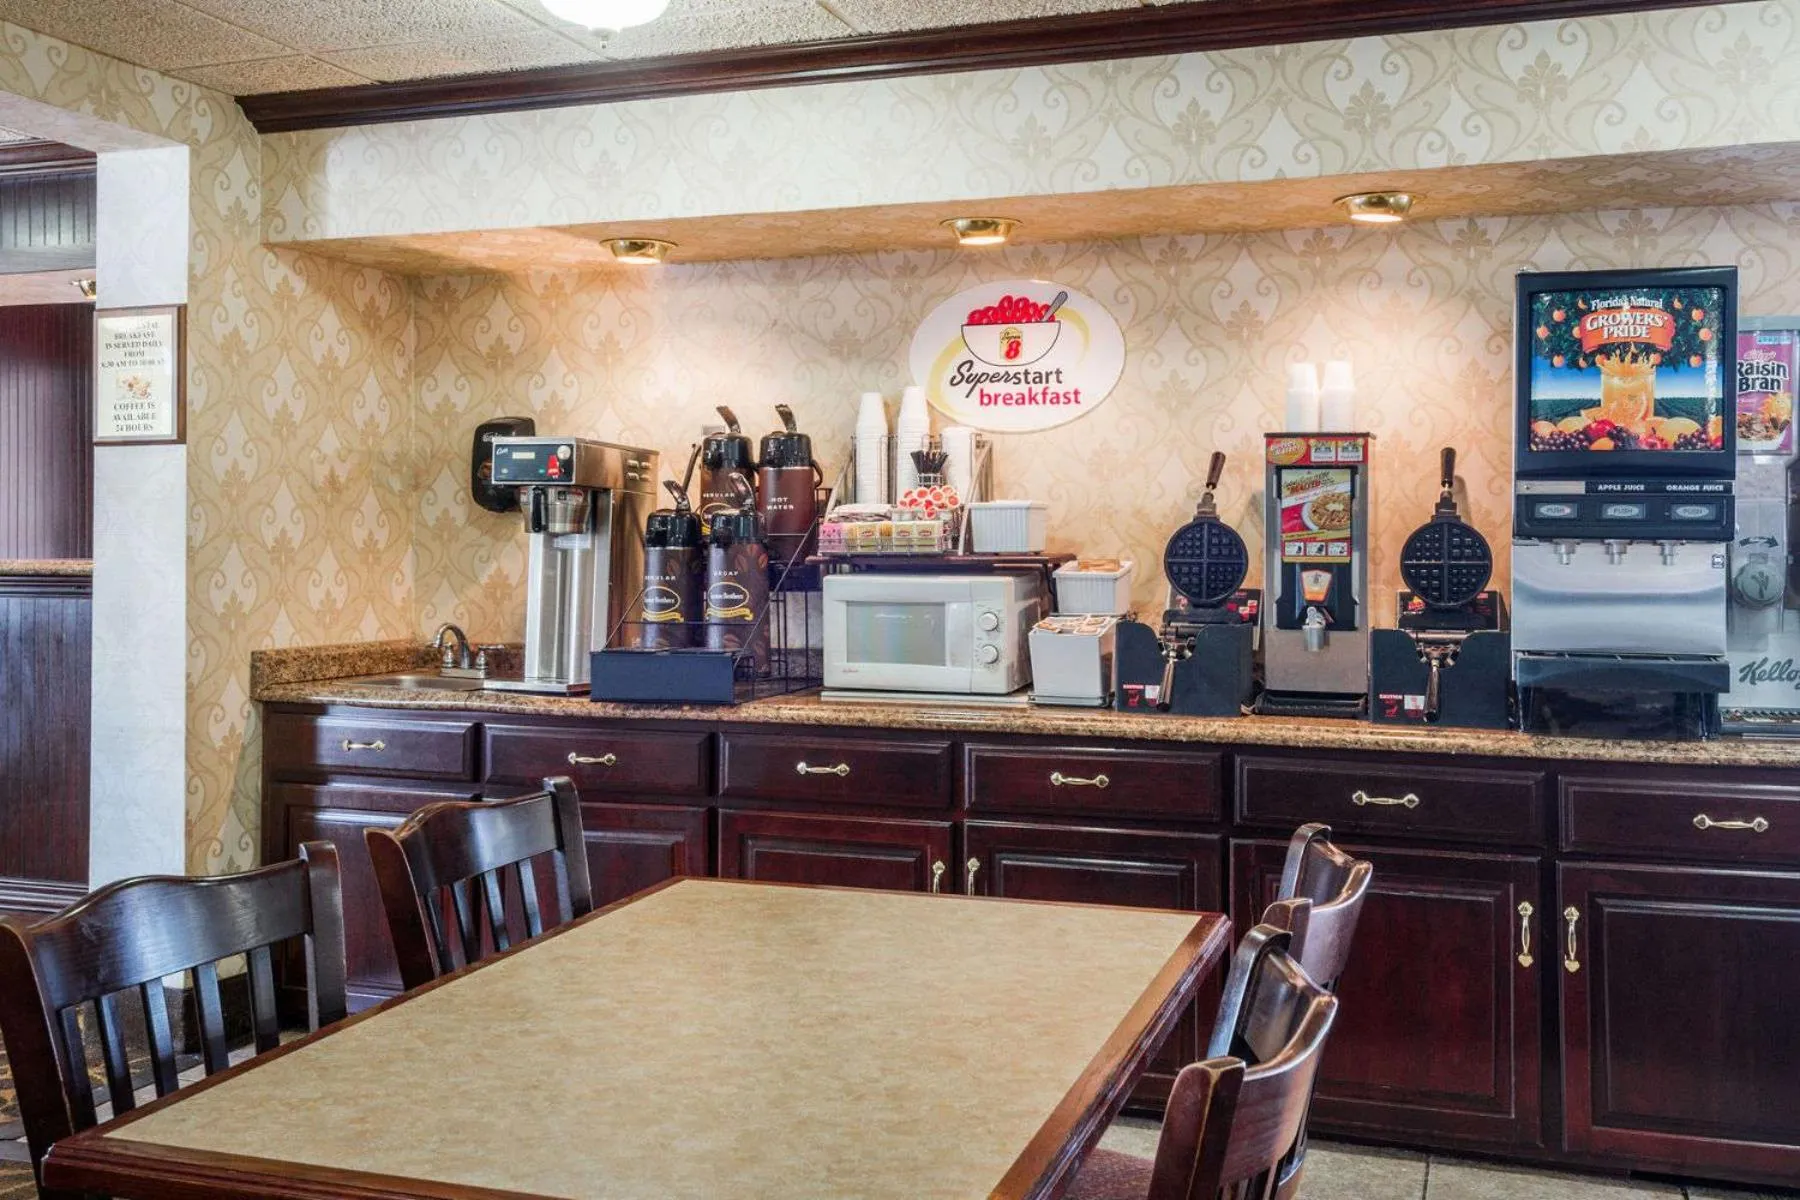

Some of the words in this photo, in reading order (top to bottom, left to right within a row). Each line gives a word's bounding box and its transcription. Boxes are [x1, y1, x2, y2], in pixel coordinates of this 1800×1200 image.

[1630, 296, 1663, 308] Natural
[1603, 325, 1651, 339] PRIDE
[1005, 340, 1021, 360] 8
[950, 359, 1063, 399] Superstart
[1738, 377, 1782, 392] Bran
[979, 387, 1082, 407] breakfast
[1597, 483, 1621, 491] APPLE
[1623, 483, 1645, 491] JUICE
[1665, 483, 1700, 491] ORANGE
[1702, 483, 1724, 491] JUICE
